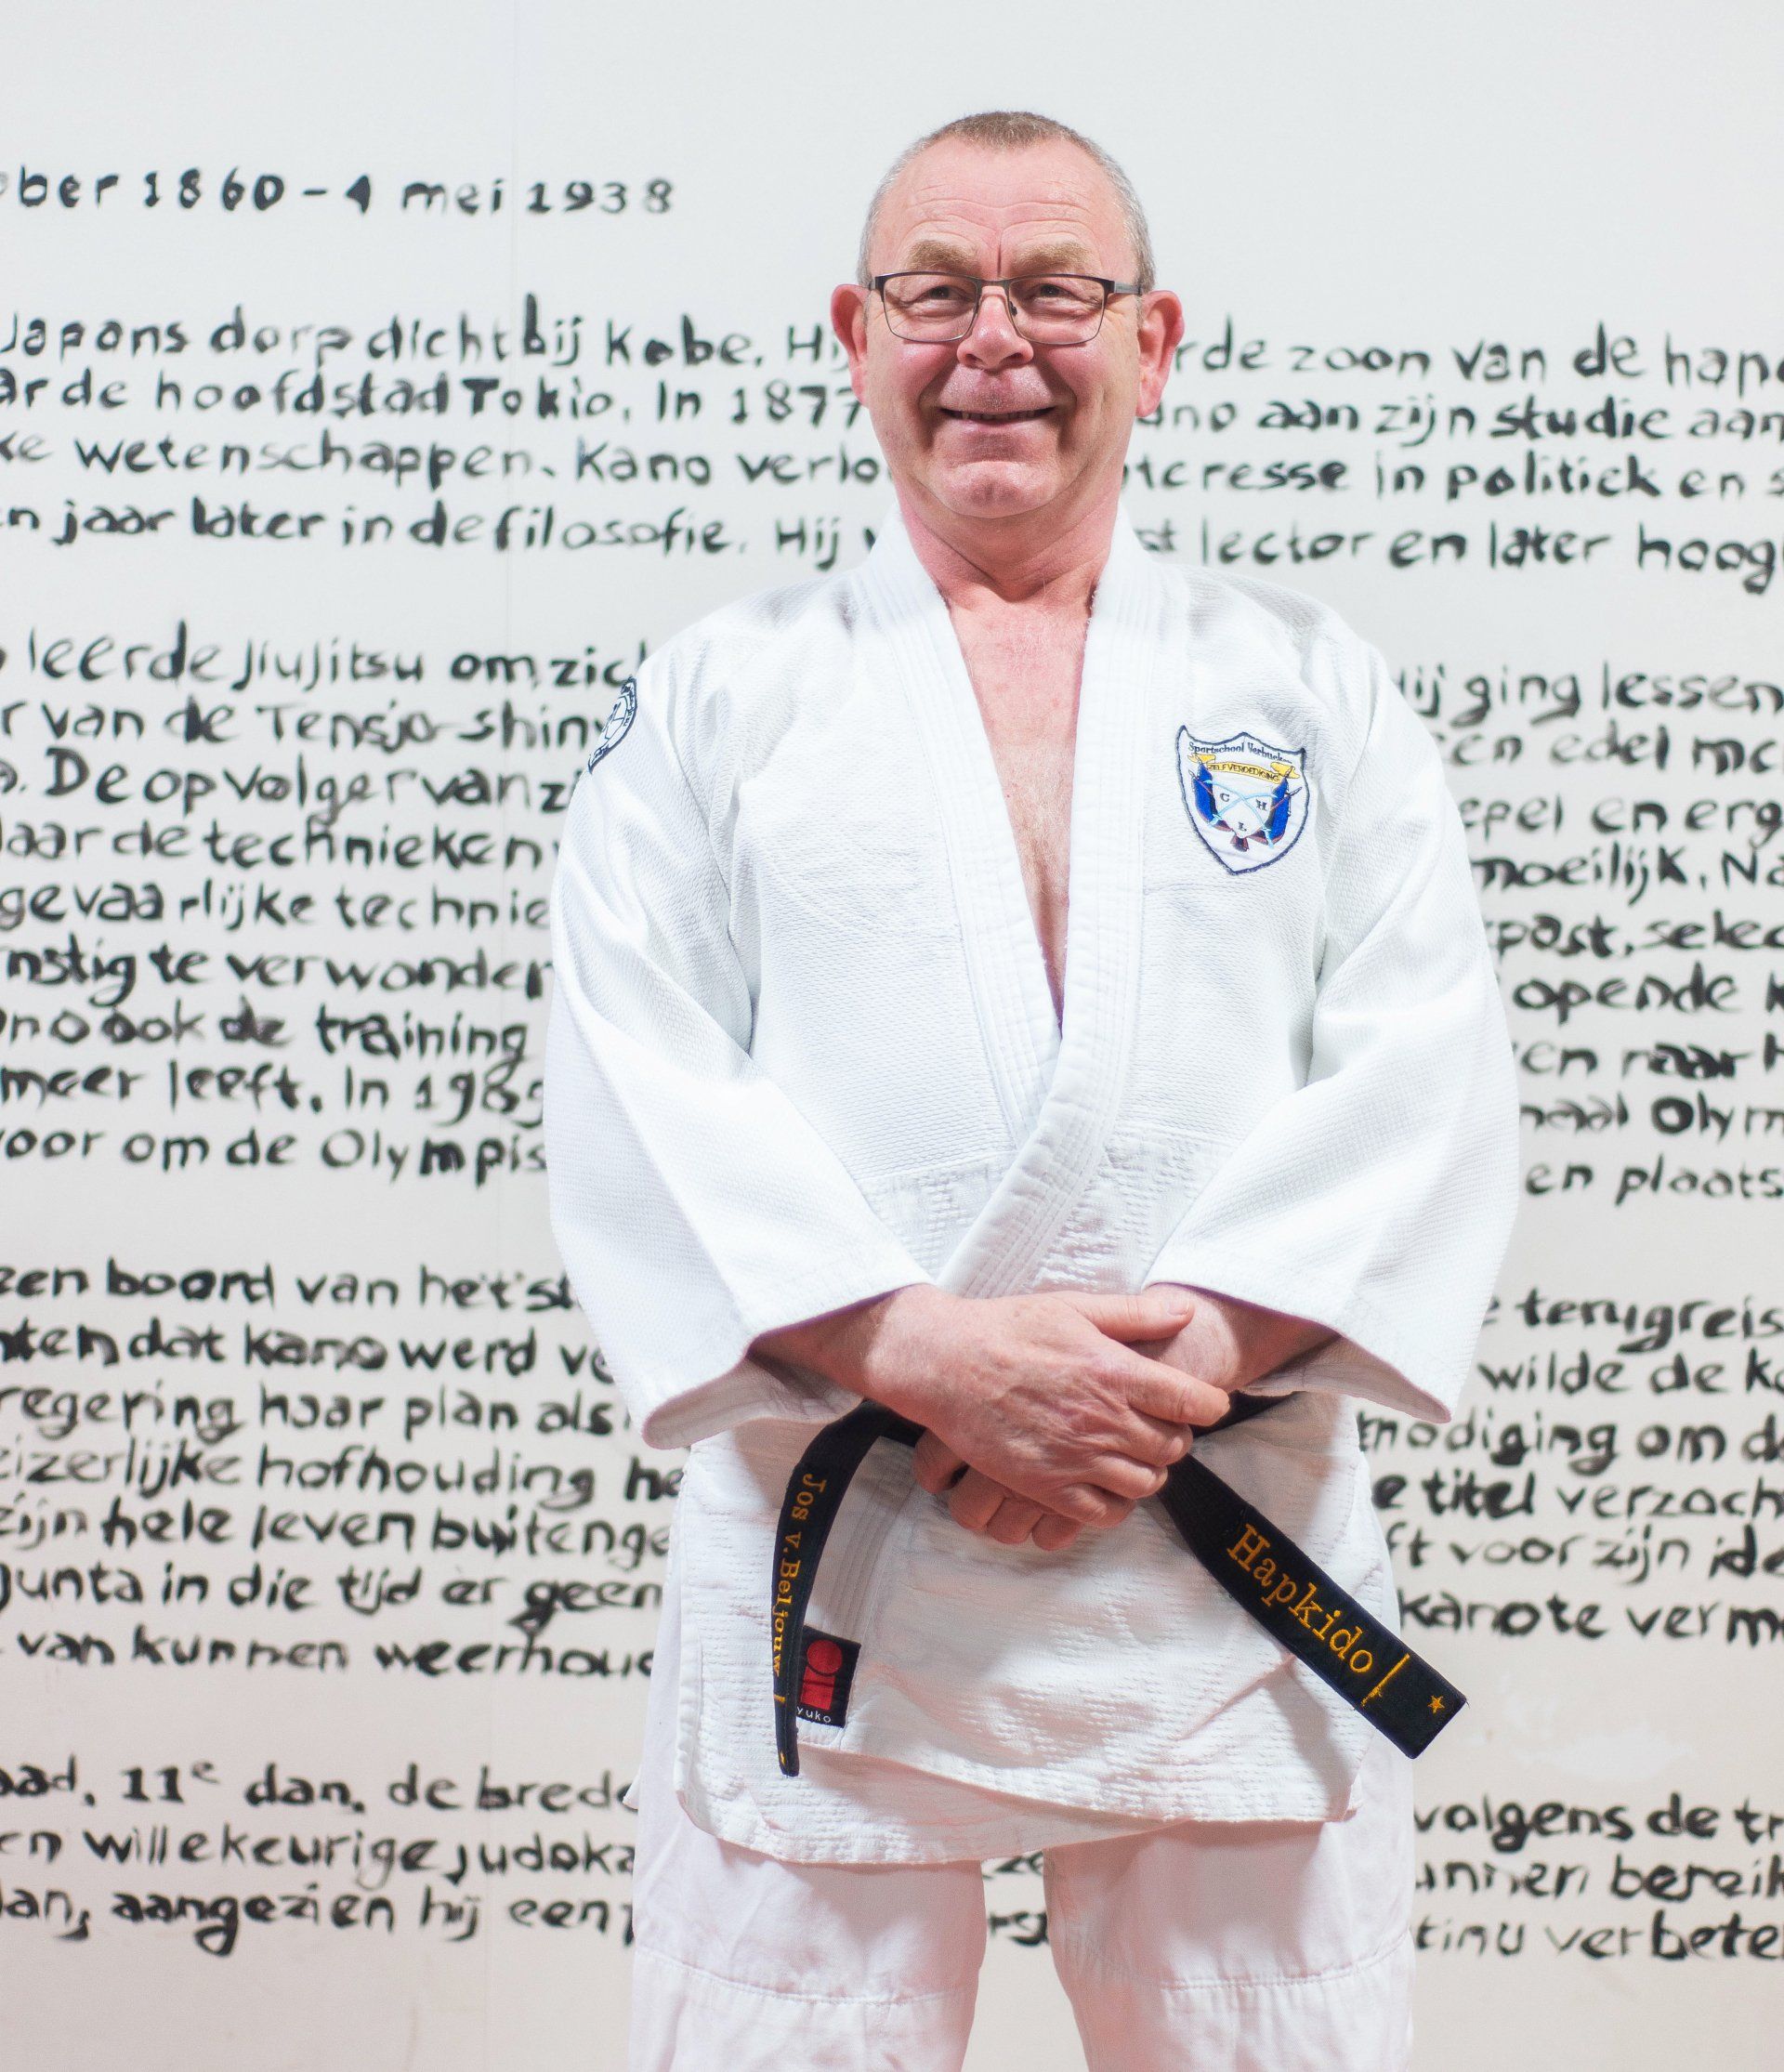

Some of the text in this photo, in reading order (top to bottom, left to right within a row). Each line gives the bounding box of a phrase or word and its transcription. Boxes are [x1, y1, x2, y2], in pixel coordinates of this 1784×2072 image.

[142, 165, 287, 214] 1860
[343, 173, 374, 216] 4
[400, 177, 505, 217] mei
[525, 177, 675, 216] 1938
[364, 311, 510, 364] dicht
[519, 290, 585, 369] bij
[1289, 344, 1433, 377] zoon
[1451, 339, 1548, 385] van
[1570, 320, 1645, 380] de
[1663, 334, 1784, 400] han
[59, 364, 128, 412] de
[154, 365, 452, 421] hoofdstad
[655, 378, 703, 423] In
[1255, 398, 1362, 434] aan
[1488, 392, 1672, 443] studie
[736, 442, 892, 485] verlo
[1120, 453, 1347, 494] teresse
[1677, 468, 1747, 501] en
[49, 497, 177, 548] jaar
[189, 493, 327, 542] later
[340, 504, 396, 548] in
[773, 515, 842, 570] Hij
[1200, 519, 1375, 568] lector
[1386, 529, 1470, 570] en
[1488, 519, 1613, 570] later
[1448, 665, 1583, 730] ging
[1600, 661, 1784, 716] lessen
[39, 701, 147, 741] van
[162, 693, 236, 746] de
[1548, 719, 1672, 773] edel
[420, 766, 532, 809] van
[1589, 799, 1671, 836] en
[0, 816, 105, 863] aar
[110, 818, 191, 860] de
[0, 933, 139, 1009] nstig
[146, 940, 211, 988] te
[97, 994, 206, 1047] ook
[1620, 1040, 1751, 1082] naar
[0, 1063, 144, 1108] meer
[343, 1064, 391, 1110] In
[0, 1126, 105, 1161] oor
[119, 1131, 212, 1174] om
[224, 1125, 299, 1169] de
[1522, 1161, 1596, 1197] en
[294, 1272, 401, 1308] van
[125, 1315, 228, 1362] dat
[397, 1325, 539, 1379] werd
[1478, 1350, 1630, 1395] wilde
[1646, 1351, 1727, 1397] de
[402, 1384, 521, 1444] plan
[533, 1390, 616, 1439] als
[1634, 1423, 1729, 1465] om
[792, 1473, 828, 1521] Jos
[1419, 1466, 1538, 1522] titel
[98, 1493, 233, 1551] hele
[249, 1502, 418, 1555] leven
[1447, 1534, 1584, 1569] voor
[1591, 1522, 1692, 1587] zijn
[160, 1559, 211, 1607] in
[226, 1560, 314, 1615] die
[439, 1576, 507, 1608] er
[1226, 1523, 1373, 1673] Hapkido
[15, 1631, 117, 1668] van
[796, 1705, 833, 1724] yuko
[386, 1761, 463, 1813] de
[1645, 1790, 1722, 1842] de
[0, 1884, 92, 1945] an,
